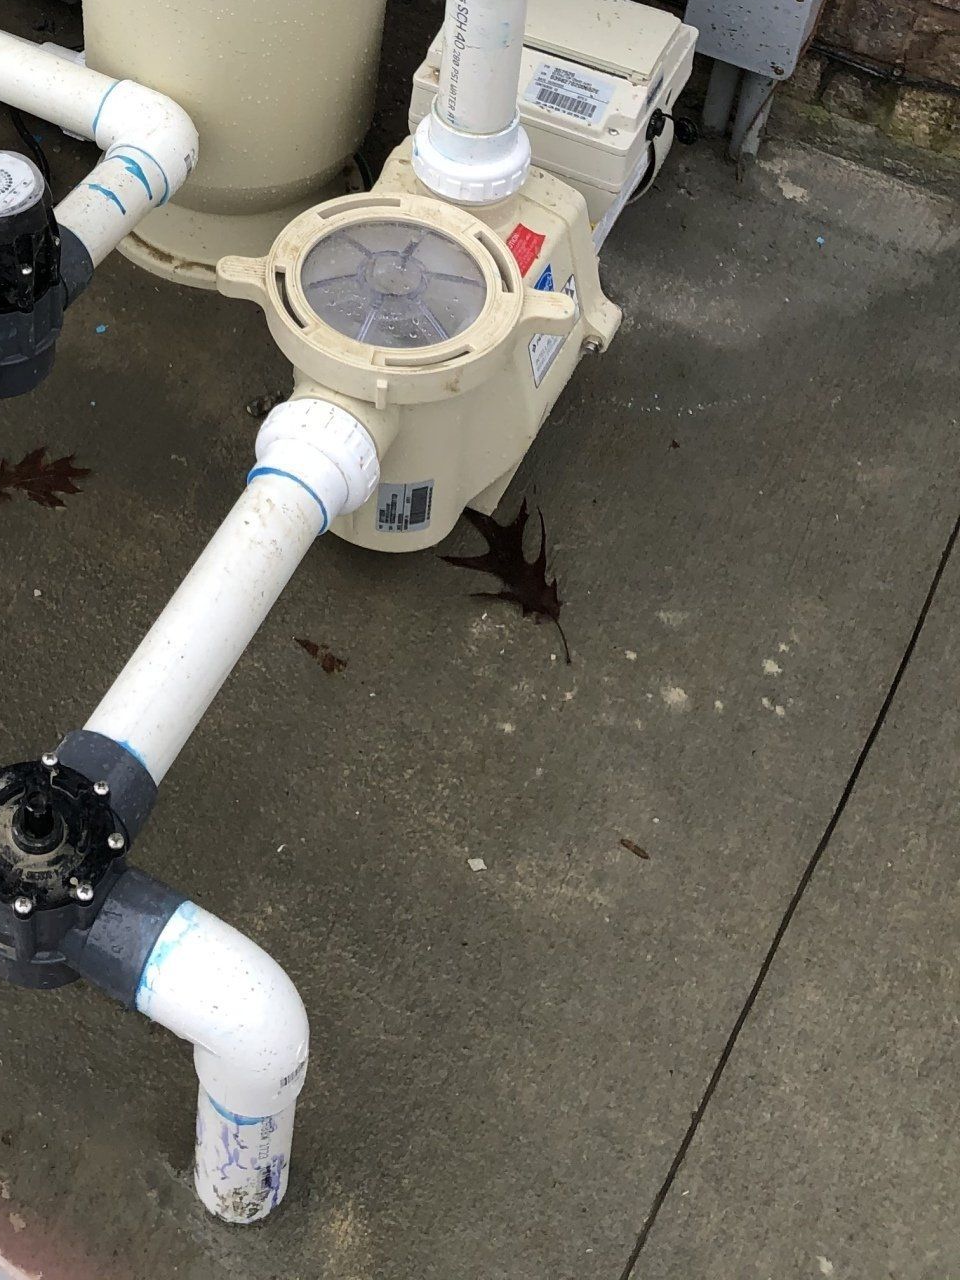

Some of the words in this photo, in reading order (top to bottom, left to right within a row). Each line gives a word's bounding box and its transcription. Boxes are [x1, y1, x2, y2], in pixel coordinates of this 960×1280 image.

[453, 3, 470, 31] SCH
[451, 31, 467, 50] 40
[448, 66, 460, 83] PSI
[445, 83, 459, 111] WATER
